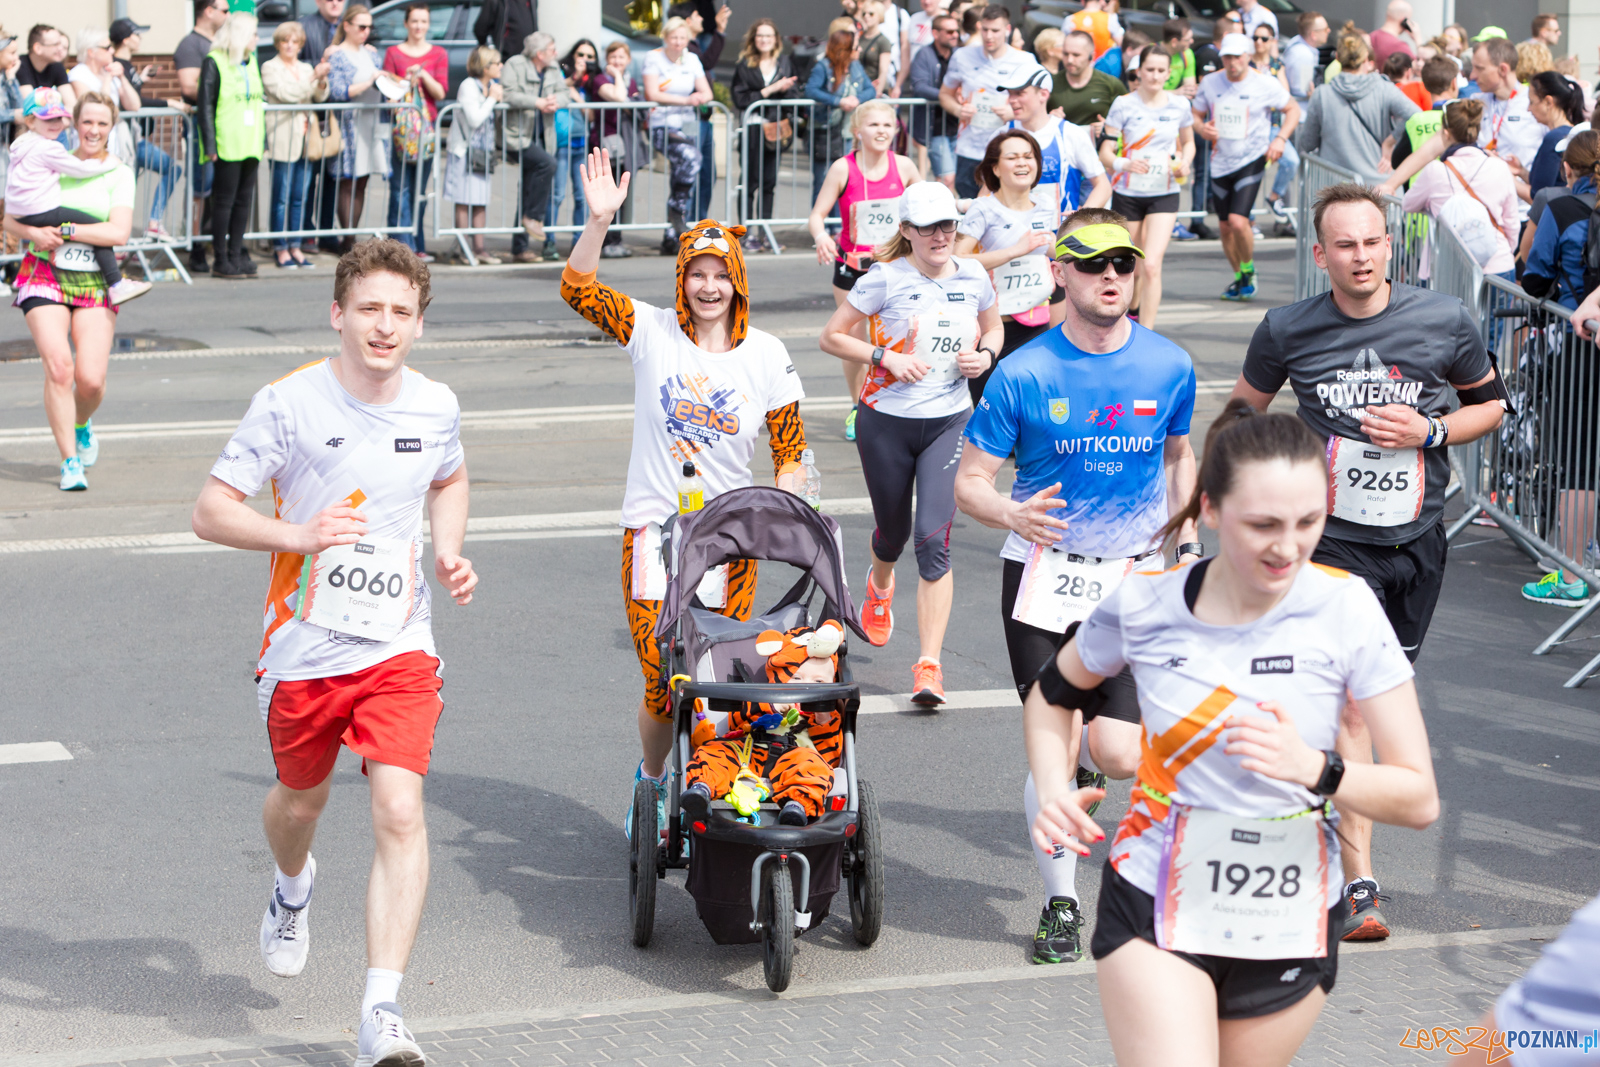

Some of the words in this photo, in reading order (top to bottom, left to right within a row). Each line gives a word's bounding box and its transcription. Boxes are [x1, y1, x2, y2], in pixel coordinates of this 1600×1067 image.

[868, 213, 894, 225] 296
[1003, 273, 1043, 290] 7722
[931, 337, 962, 353] 786
[1336, 369, 1387, 381] Reebok
[1316, 381, 1423, 405] POWERUN
[675, 400, 739, 434] eska
[1325, 408, 1340, 419] BY
[670, 427, 706, 443] MINISTRA
[683, 424, 718, 441] ESKADRA
[1055, 436, 1153, 454] WITKOWO
[1084, 459, 1123, 475] biega
[1347, 467, 1409, 492] 9265
[328, 564, 404, 599] 6060
[1053, 573, 1103, 602] 288
[348, 596, 380, 610] Tomasz
[1207, 860, 1302, 898] 1928
[1212, 902, 1280, 918] Aleksandra
